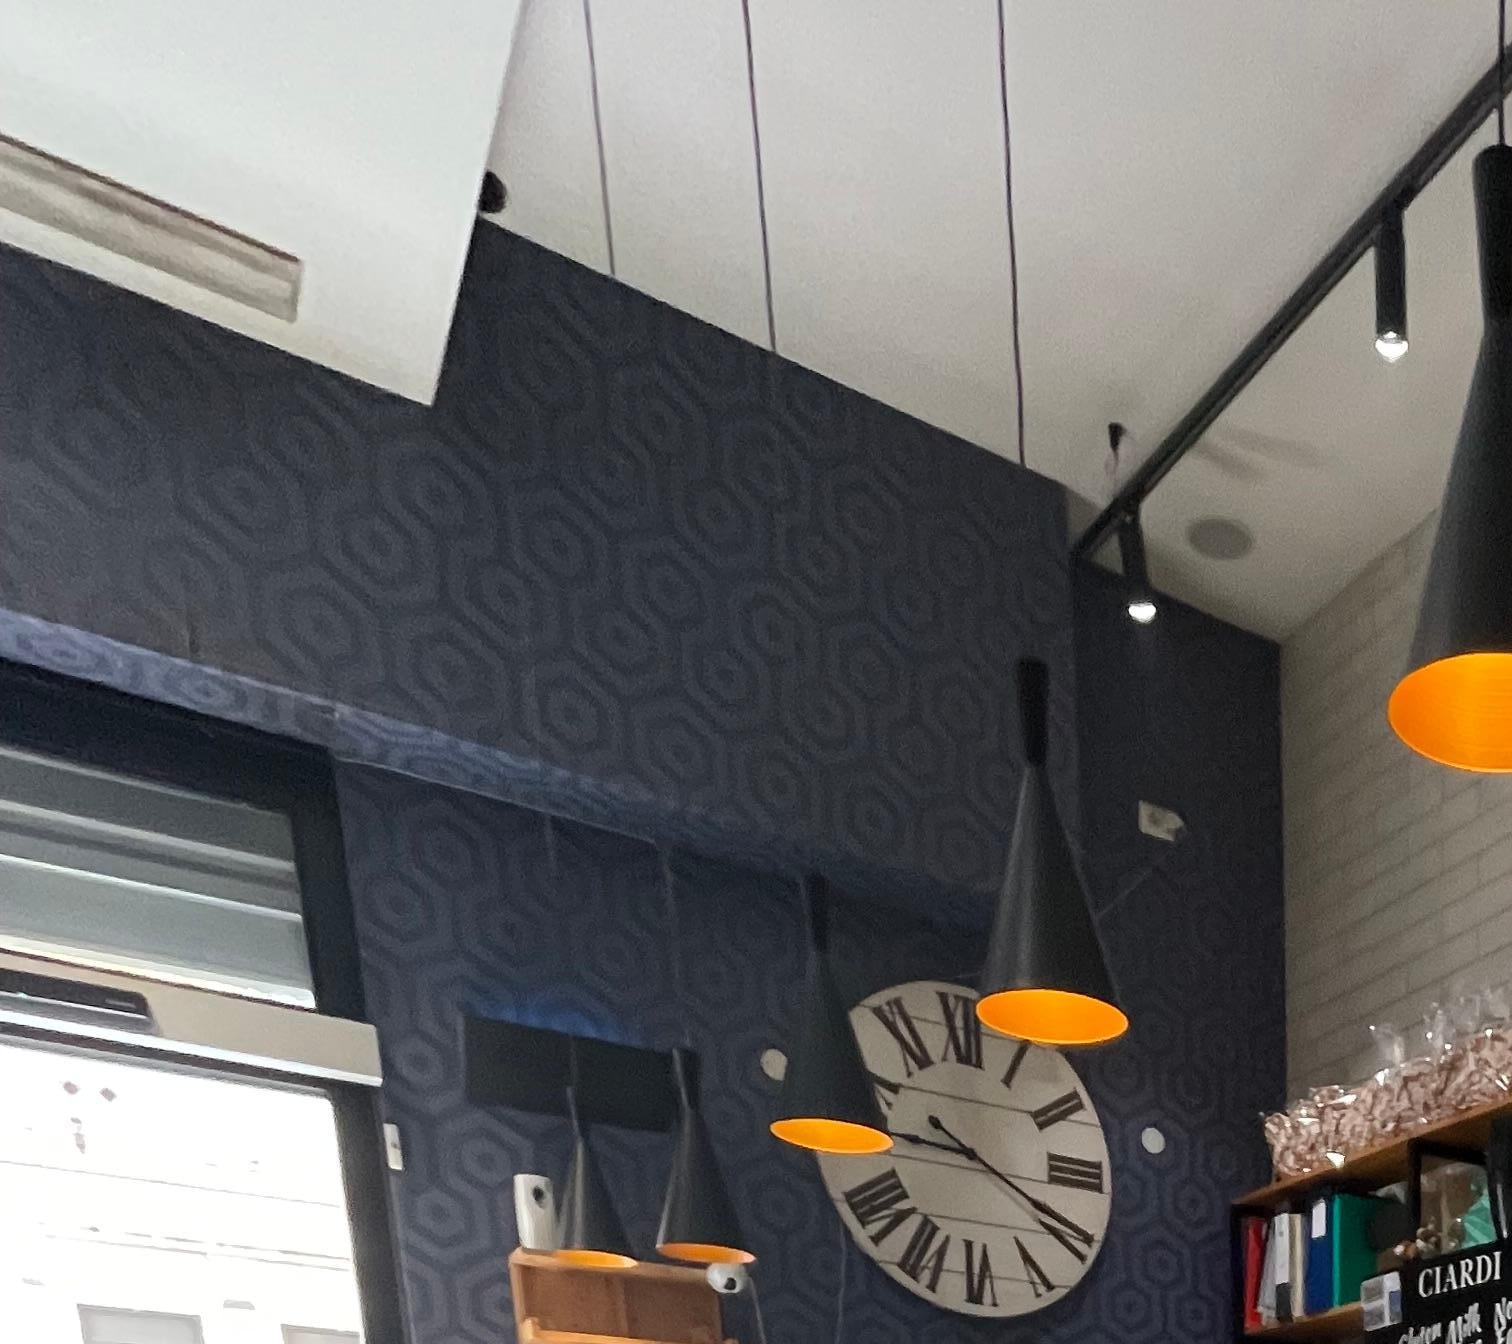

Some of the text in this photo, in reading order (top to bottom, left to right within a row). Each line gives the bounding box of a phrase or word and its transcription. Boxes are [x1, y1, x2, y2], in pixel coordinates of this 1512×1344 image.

[1030, 1086, 1085, 1132] II
[1046, 1152, 1105, 1194] III
[962, 1238, 999, 1308] VI
[1013, 1235, 1055, 1299] V
[1418, 1251, 1502, 1298] CIARDI
